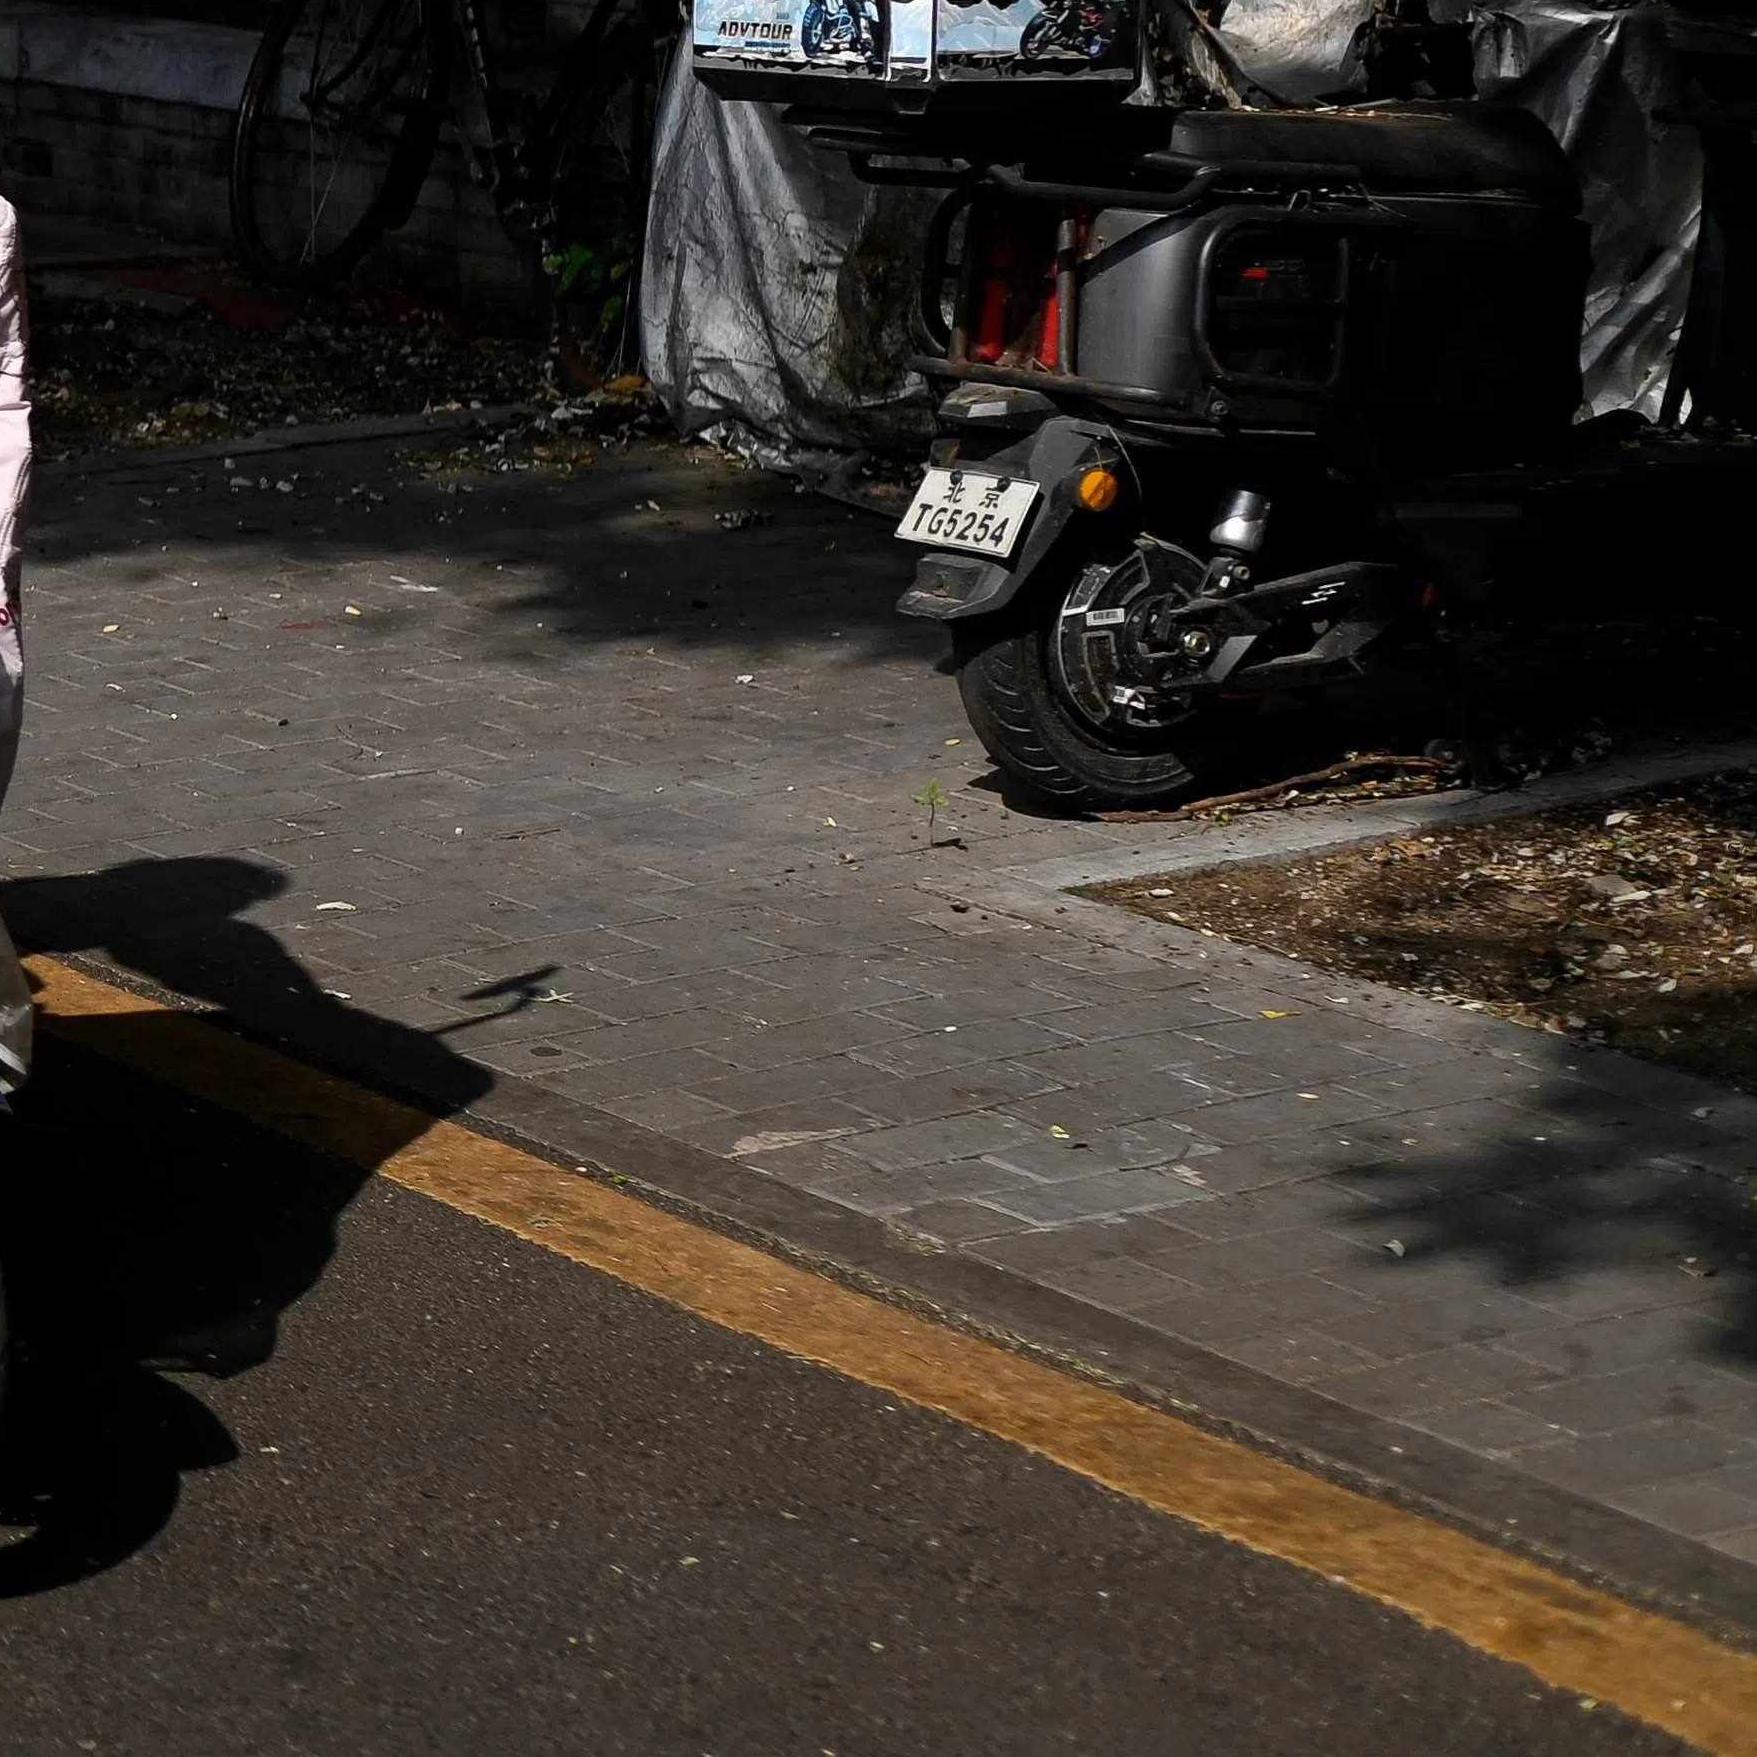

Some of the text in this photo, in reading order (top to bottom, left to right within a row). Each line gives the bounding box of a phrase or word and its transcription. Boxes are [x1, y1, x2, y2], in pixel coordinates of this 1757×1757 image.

[717, 20, 793, 40] ADVTOUR
[943, 482, 1002, 509] 北京
[912, 503, 1010, 547] TG5254
